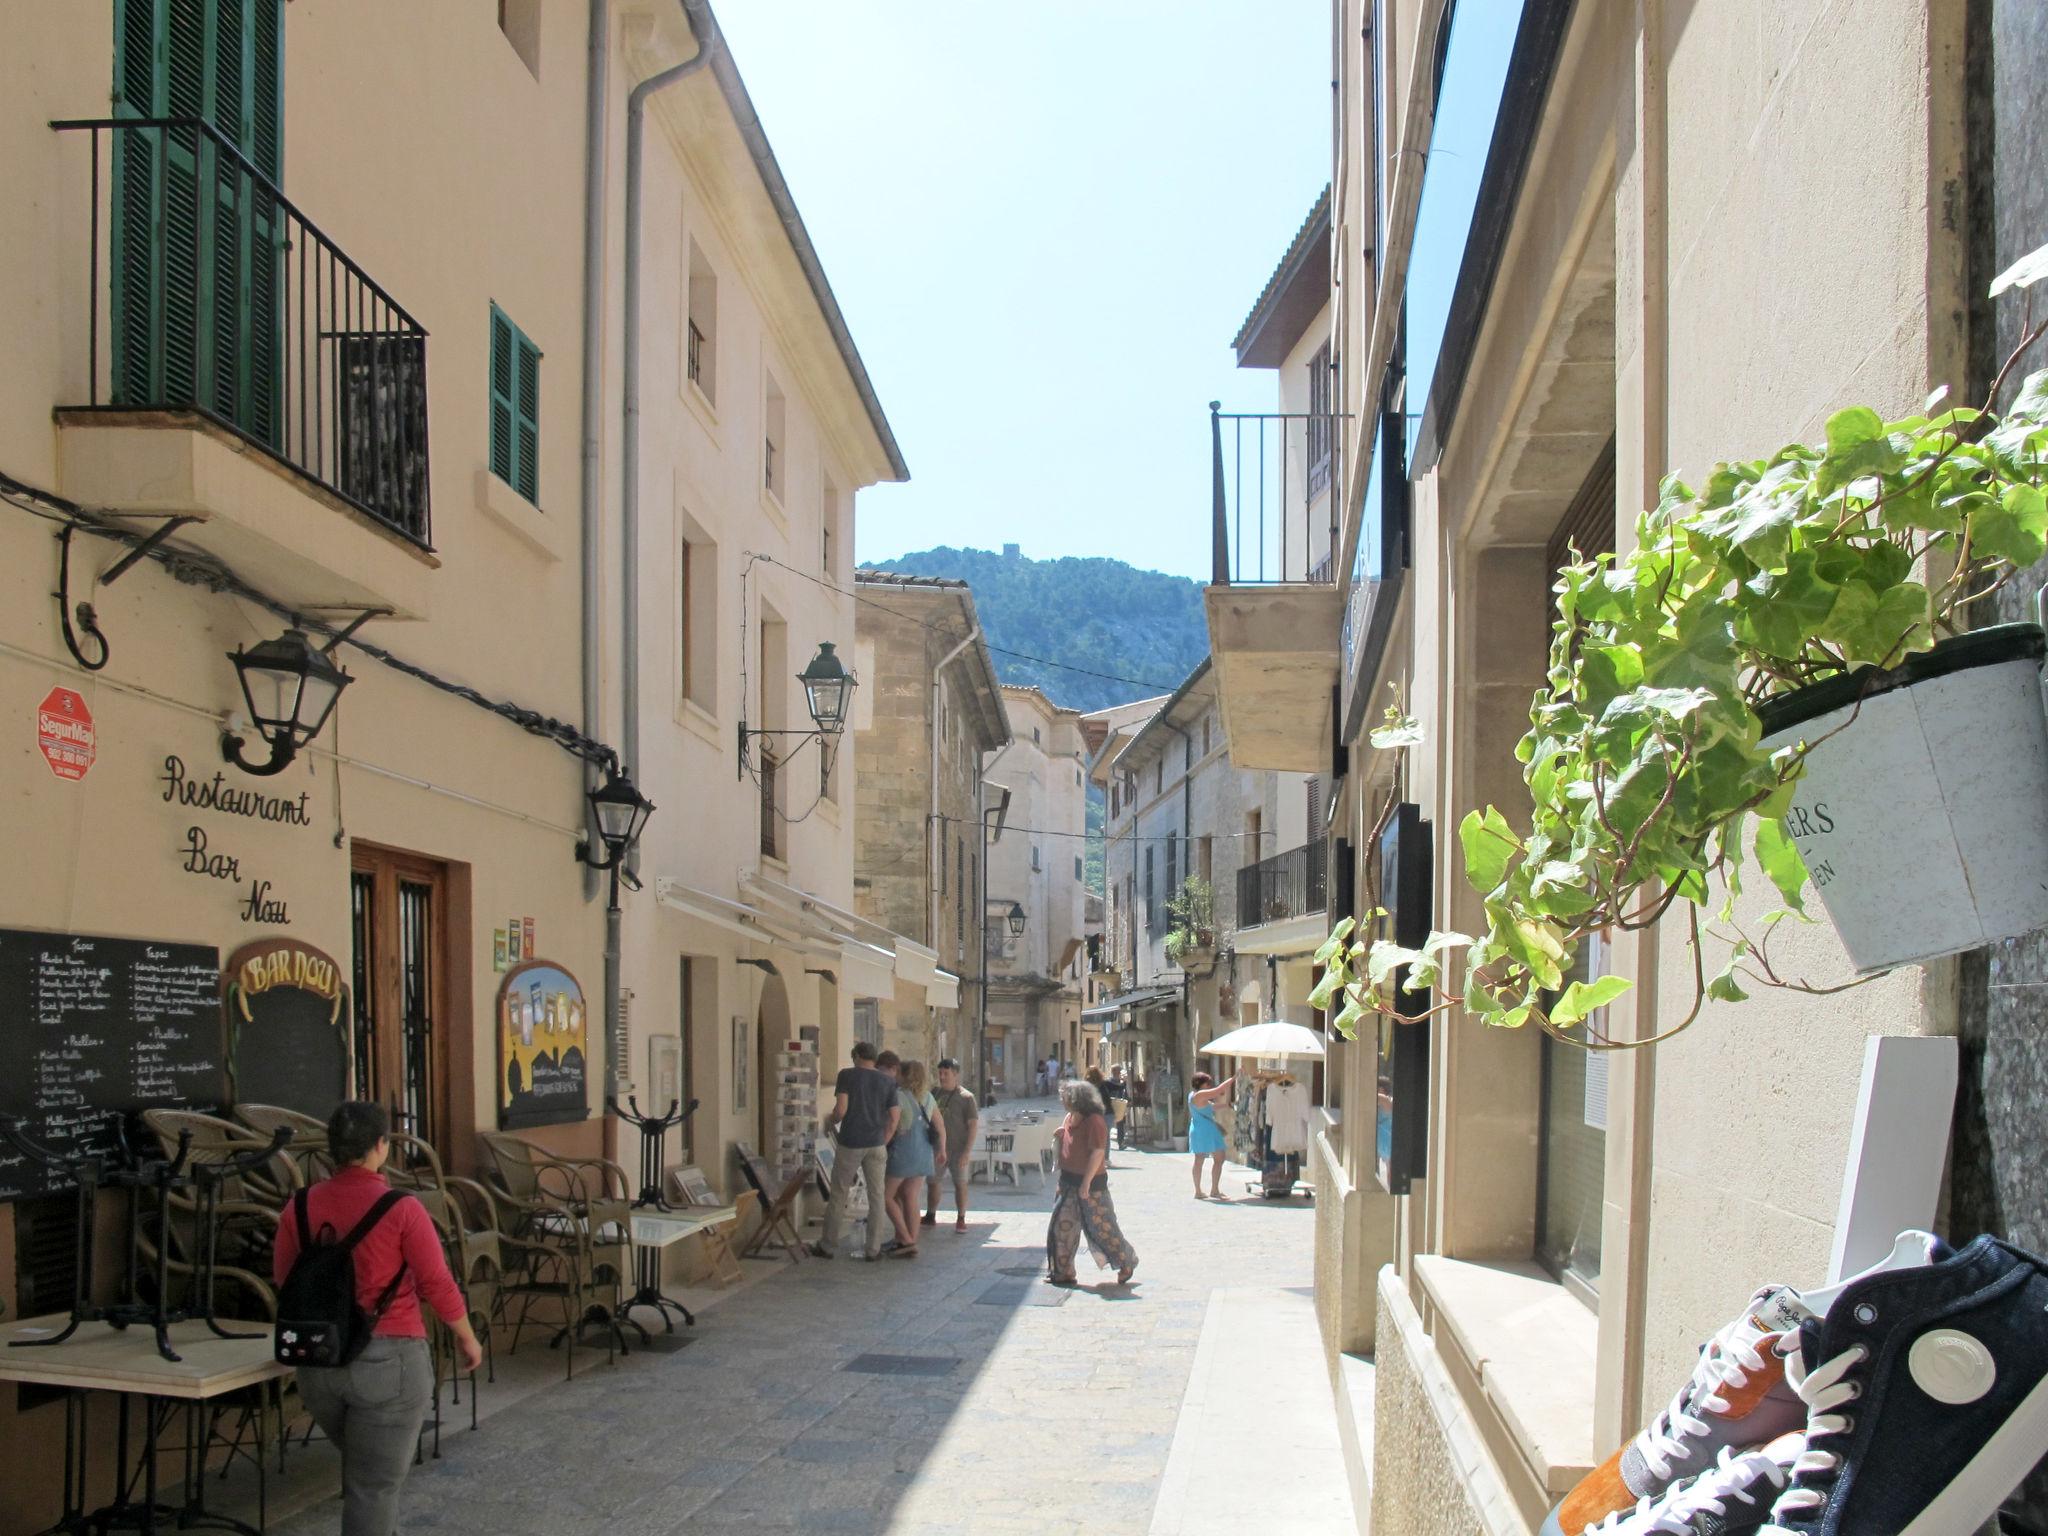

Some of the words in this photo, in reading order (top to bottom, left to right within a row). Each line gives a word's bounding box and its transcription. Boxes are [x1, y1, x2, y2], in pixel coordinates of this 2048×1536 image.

[161, 755, 310, 826] Restaurant
[1786, 803, 1834, 838] ERS
[181, 826, 241, 883] Bar
[240, 879, 290, 924] Nou
[146, 946, 169, 960] Tapas
[248, 949, 291, 992] BAR
